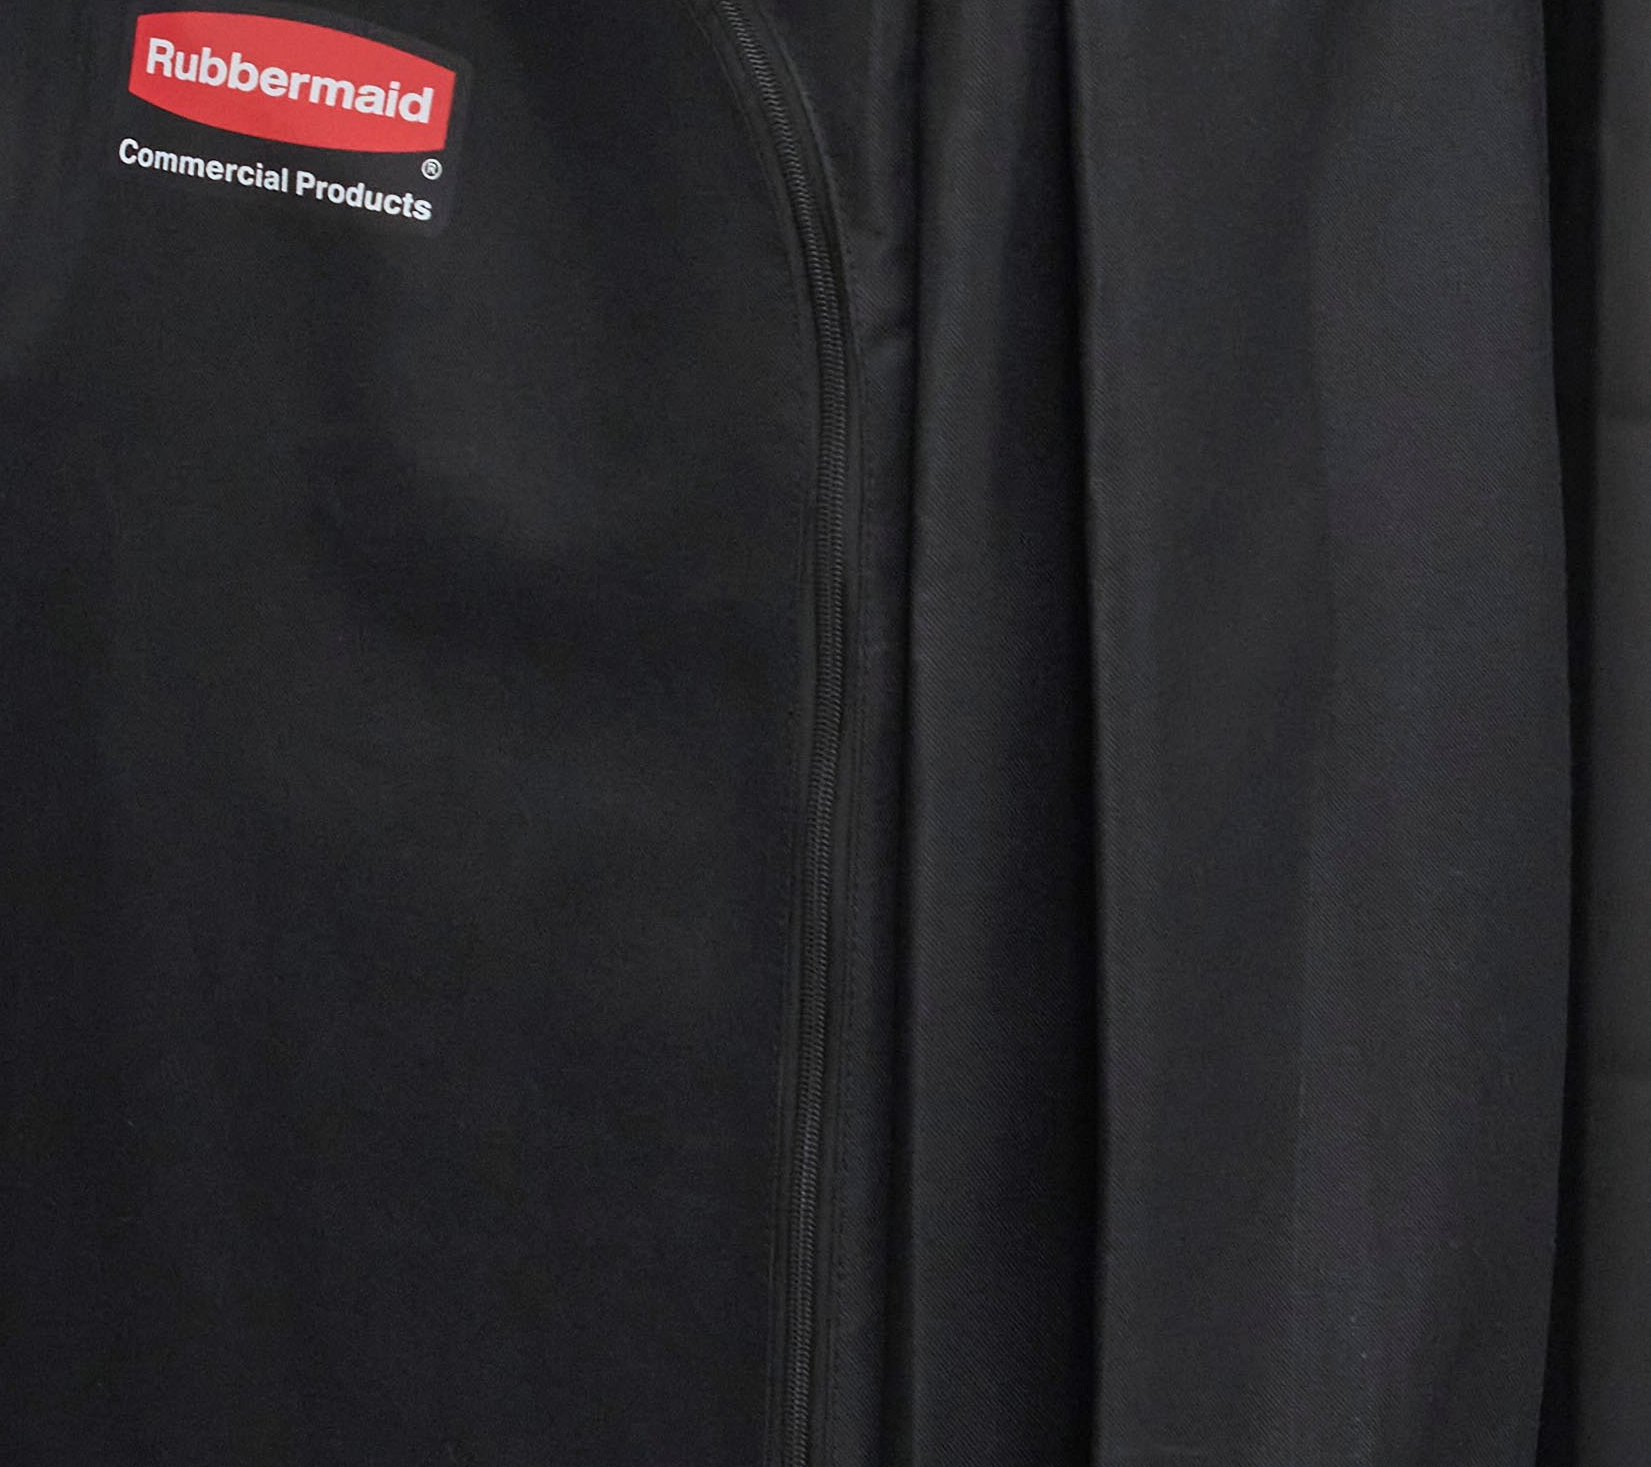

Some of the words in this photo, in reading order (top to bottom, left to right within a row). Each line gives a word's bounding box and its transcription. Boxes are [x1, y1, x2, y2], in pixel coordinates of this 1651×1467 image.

[146, 37, 434, 124] Rubbermaid
[118, 137, 289, 193] Commercial
[296, 170, 433, 221] Products
